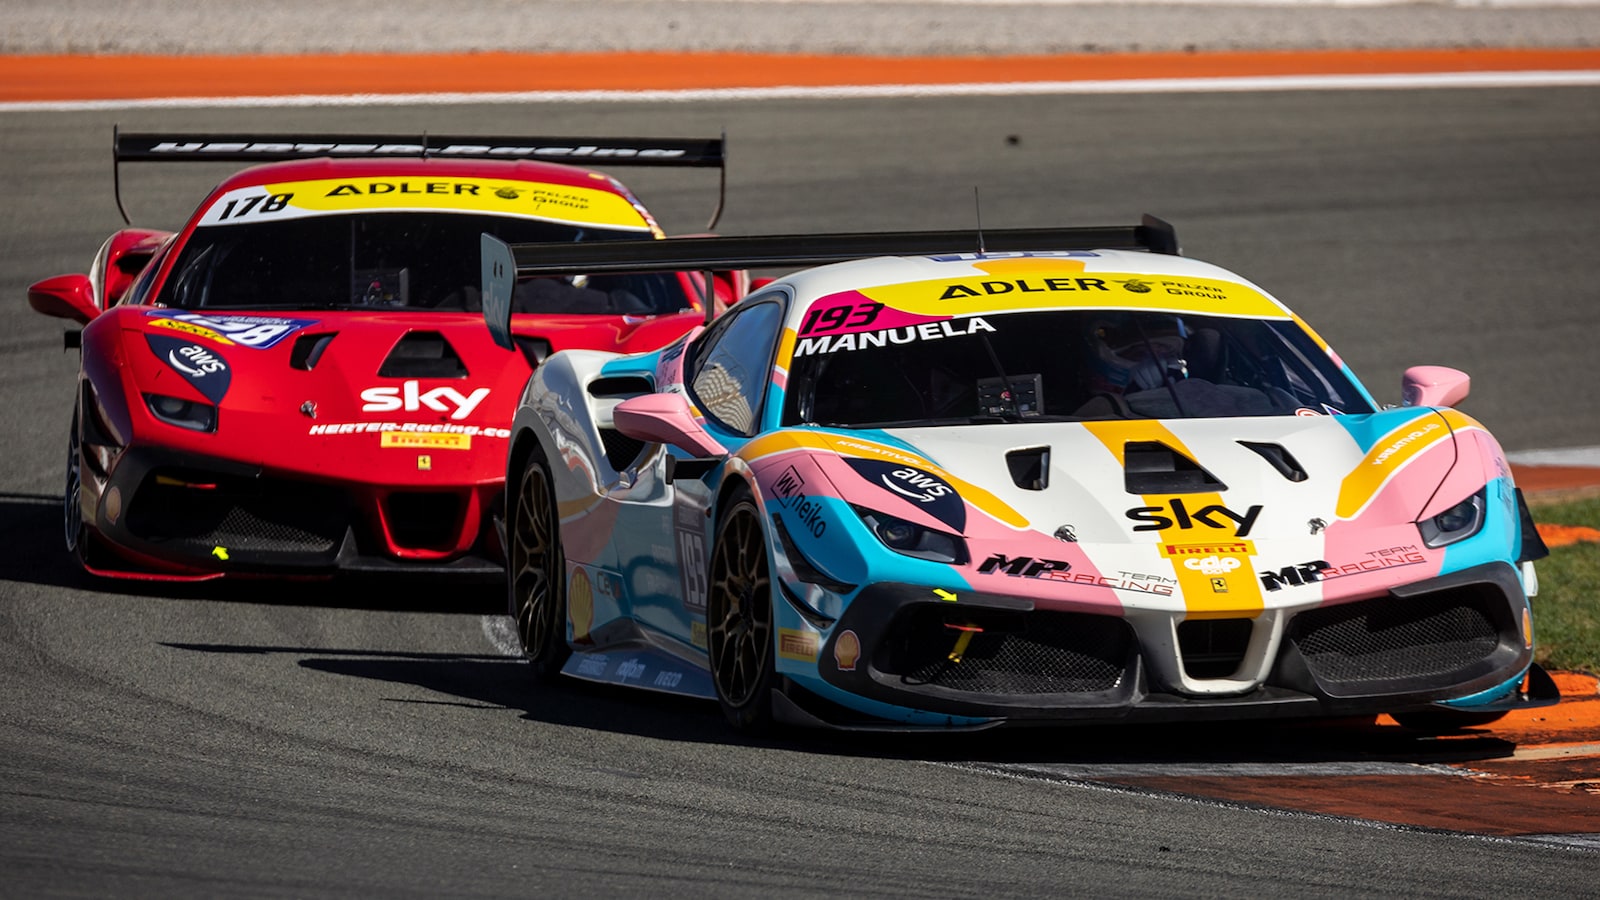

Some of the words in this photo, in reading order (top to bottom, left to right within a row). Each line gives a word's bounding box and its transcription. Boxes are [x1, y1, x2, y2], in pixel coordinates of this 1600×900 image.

[218, 193, 294, 221] 178
[325, 182, 480, 198] ADLER
[1161, 281, 1222, 293] PELZER
[1166, 288, 1227, 300] GROUP
[801, 303, 885, 334] 193
[939, 278, 1110, 300] ADLER
[794, 317, 996, 357] MANUELA
[179, 345, 226, 374] aws
[360, 380, 491, 420] sky
[309, 422, 511, 438] HERTER-Racing.co
[891, 467, 953, 497] aws
[791, 491, 827, 539] neiko
[1125, 498, 1264, 537] sky
[1166, 542, 1248, 555] PIRELLI
[1365, 545, 1418, 559] TEAM
[977, 553, 1072, 578] MP
[1117, 571, 1178, 585] TEAM
[1259, 560, 1332, 592] MP
[1320, 552, 1425, 578] RACING
[1050, 572, 1174, 596] RACING
